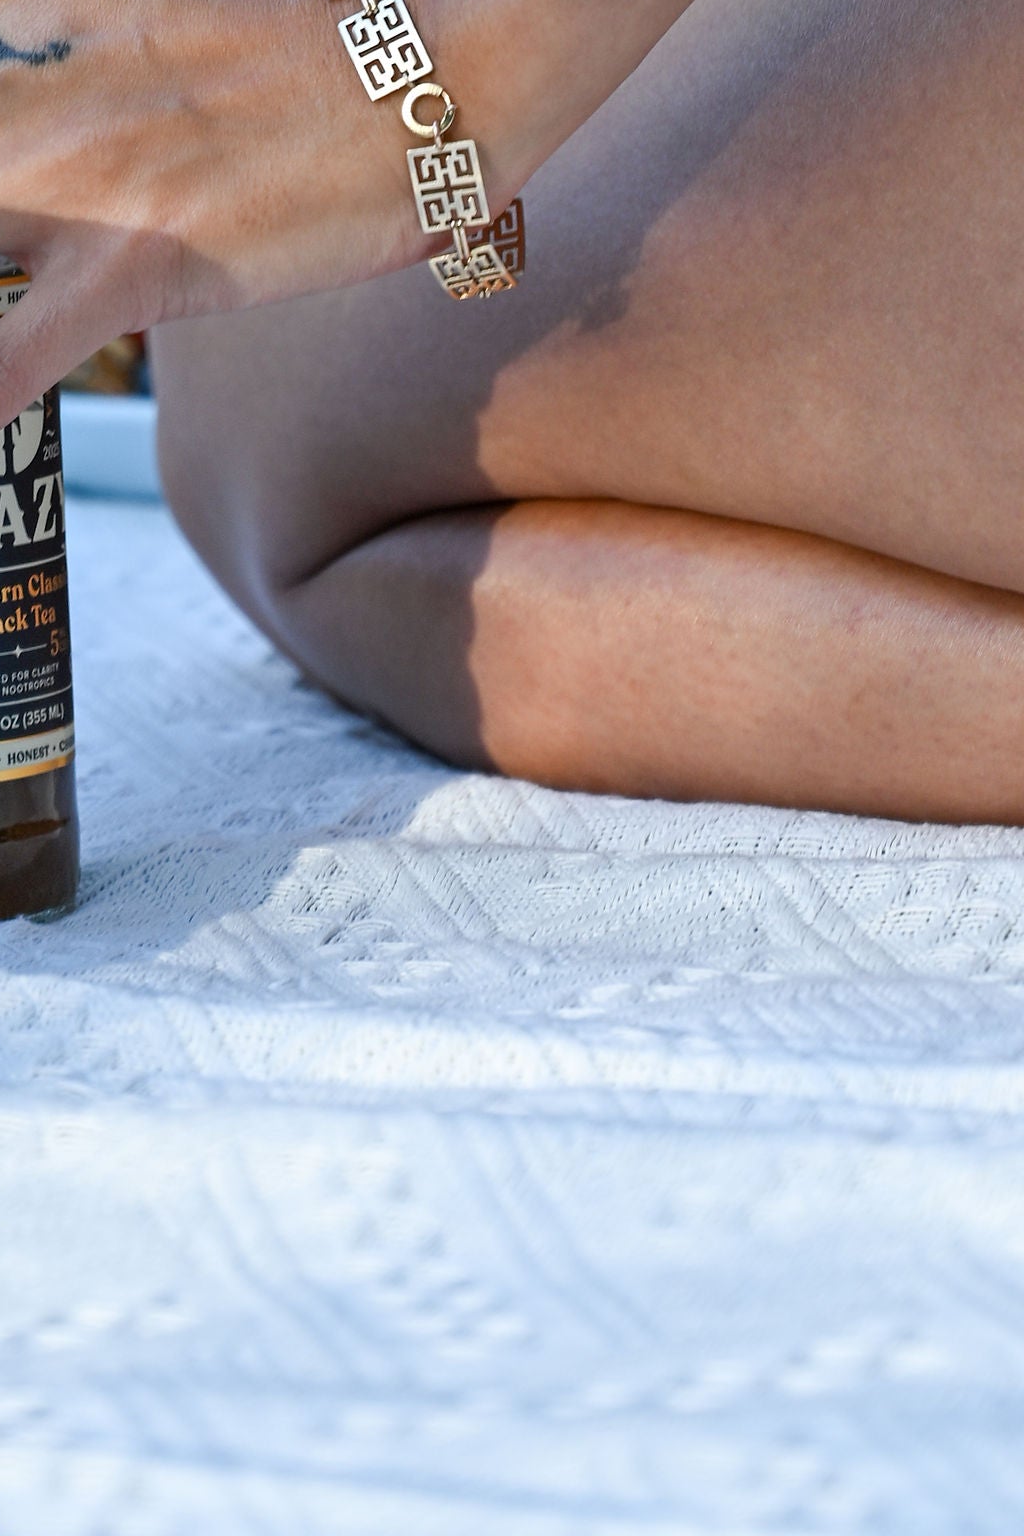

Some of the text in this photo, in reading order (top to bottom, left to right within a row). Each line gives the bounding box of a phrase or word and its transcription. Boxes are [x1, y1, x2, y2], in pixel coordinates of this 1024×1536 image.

[31, 604, 57, 628] Tea
[11, 667, 30, 683] FOR
[31, 662, 59, 679] CLARITY
[2, 676, 55, 697] NOOTROPICS
[0, 713, 20, 730] OZ
[23, 710, 47, 730] (355
[48, 702, 65, 722] ML)
[7, 744, 50, 765] HONEST
